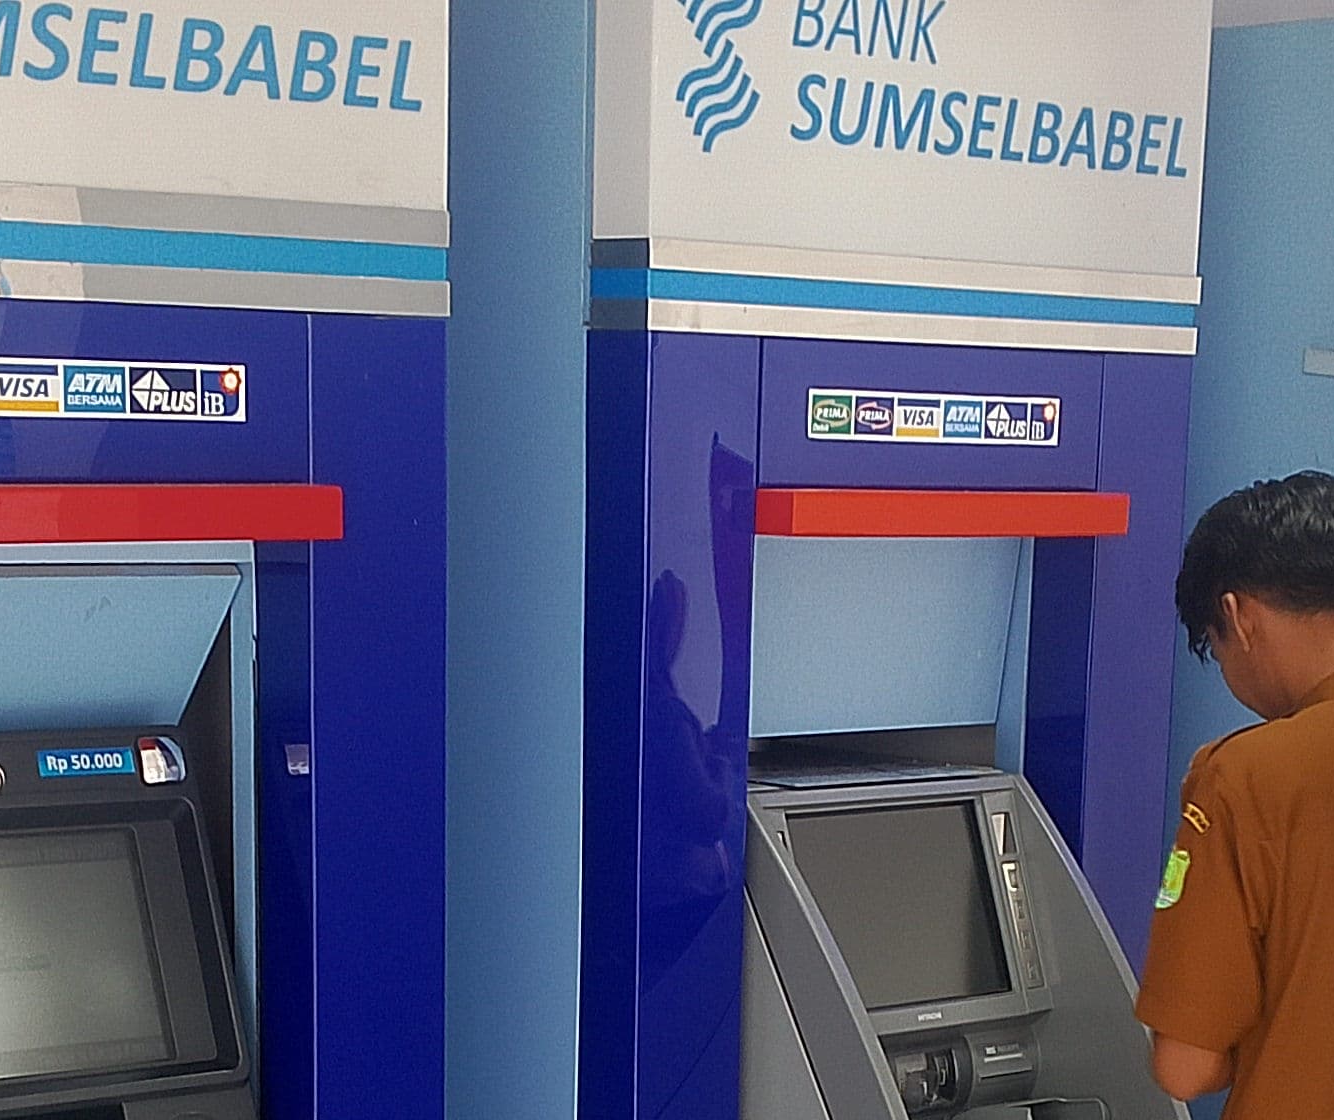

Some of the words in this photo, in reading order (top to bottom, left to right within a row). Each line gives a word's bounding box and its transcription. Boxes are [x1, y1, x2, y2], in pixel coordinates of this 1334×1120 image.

[792, 0, 946, 64] BANK
[790, 73, 1187, 178] SUMSELBABEL
[68, 374, 123, 393] ATM
[67, 395, 123, 406] BERSAMA
[149, 390, 196, 413] PLUS
[203, 391, 225, 415] iB
[816, 408, 848, 419] PRIMA
[859, 410, 891, 422] PRIMA
[902, 409, 935, 426] VISA
[946, 406, 981, 423] ATM
[997, 419, 1027, 438] PLUS
[46, 755, 68, 774] Rp
[71, 753, 123, 770] 50.000
